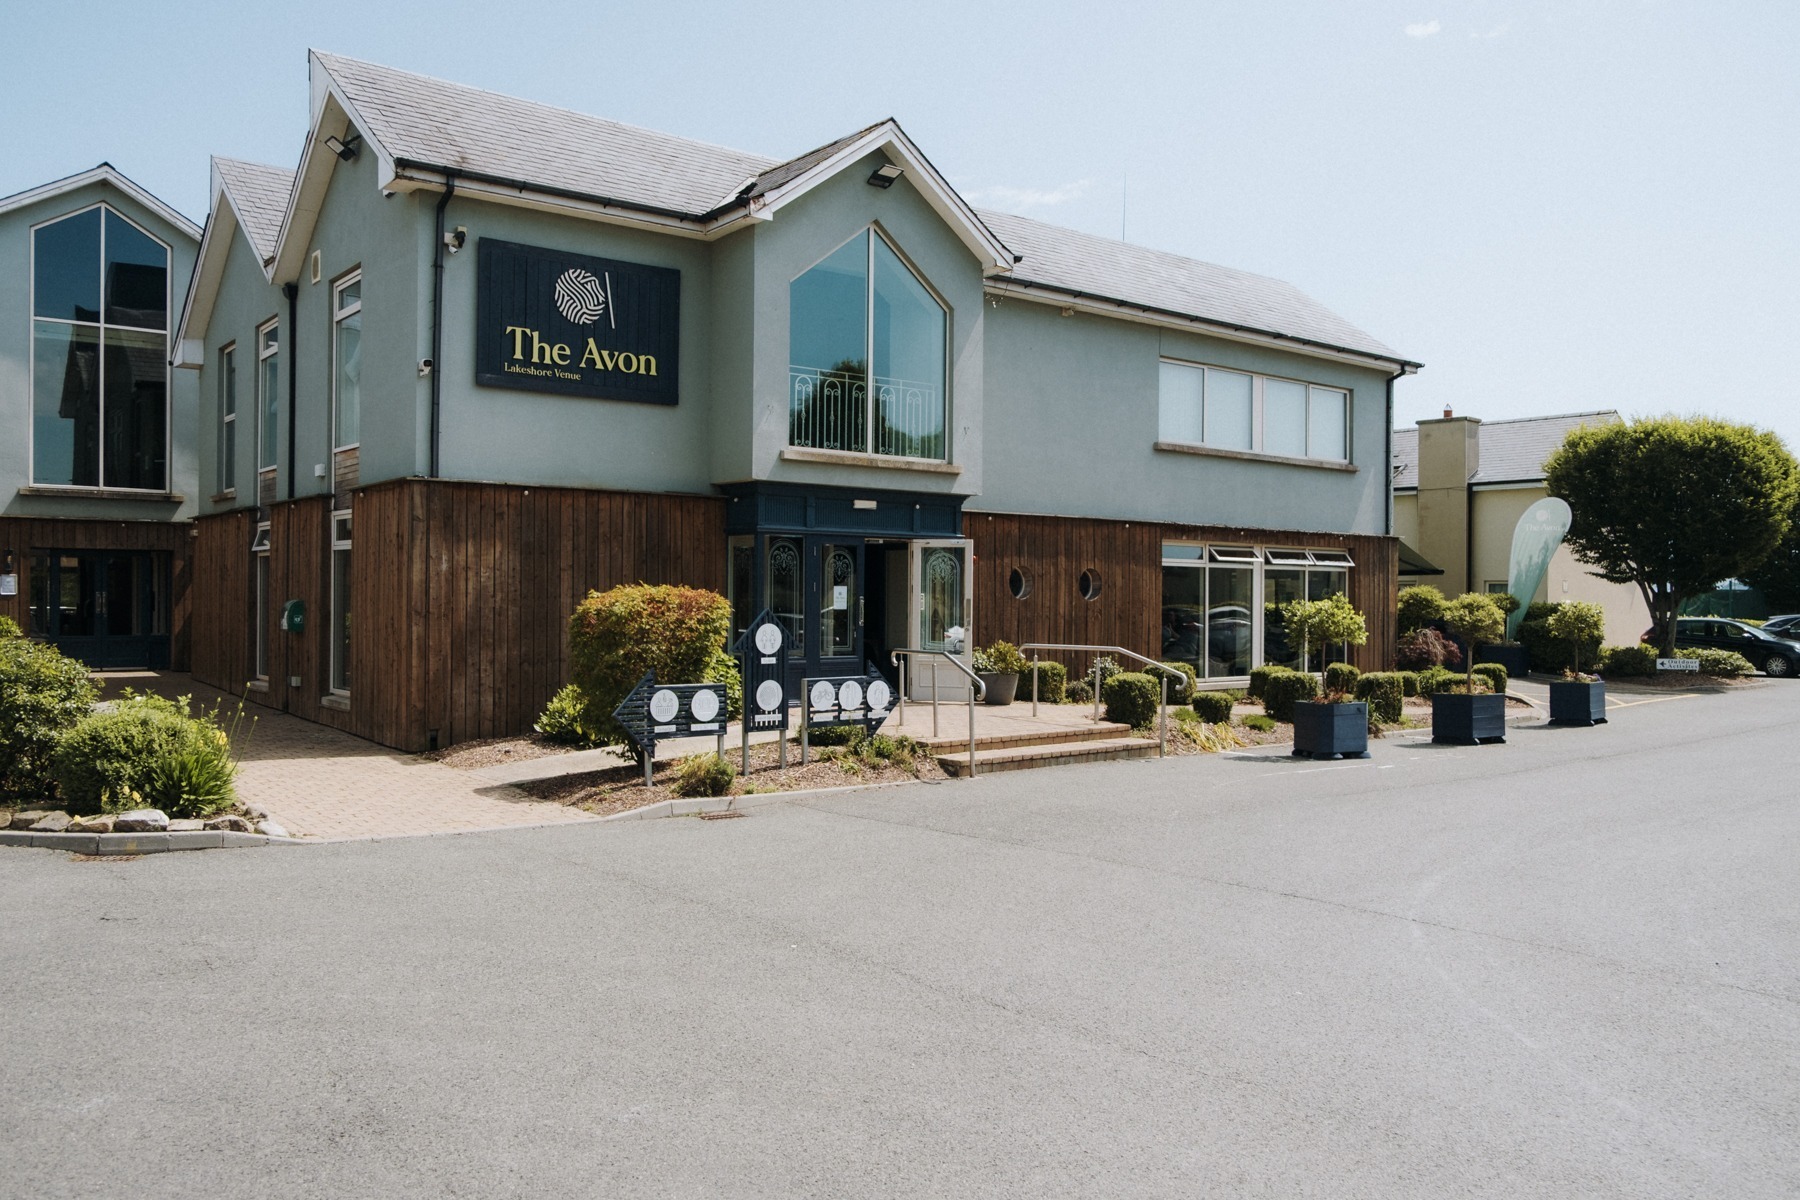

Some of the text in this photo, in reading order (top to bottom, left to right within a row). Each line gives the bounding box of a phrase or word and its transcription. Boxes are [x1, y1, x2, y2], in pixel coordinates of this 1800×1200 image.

[506, 326, 658, 376] The Avon
[504, 362, 582, 381] Lakeshore Venue
